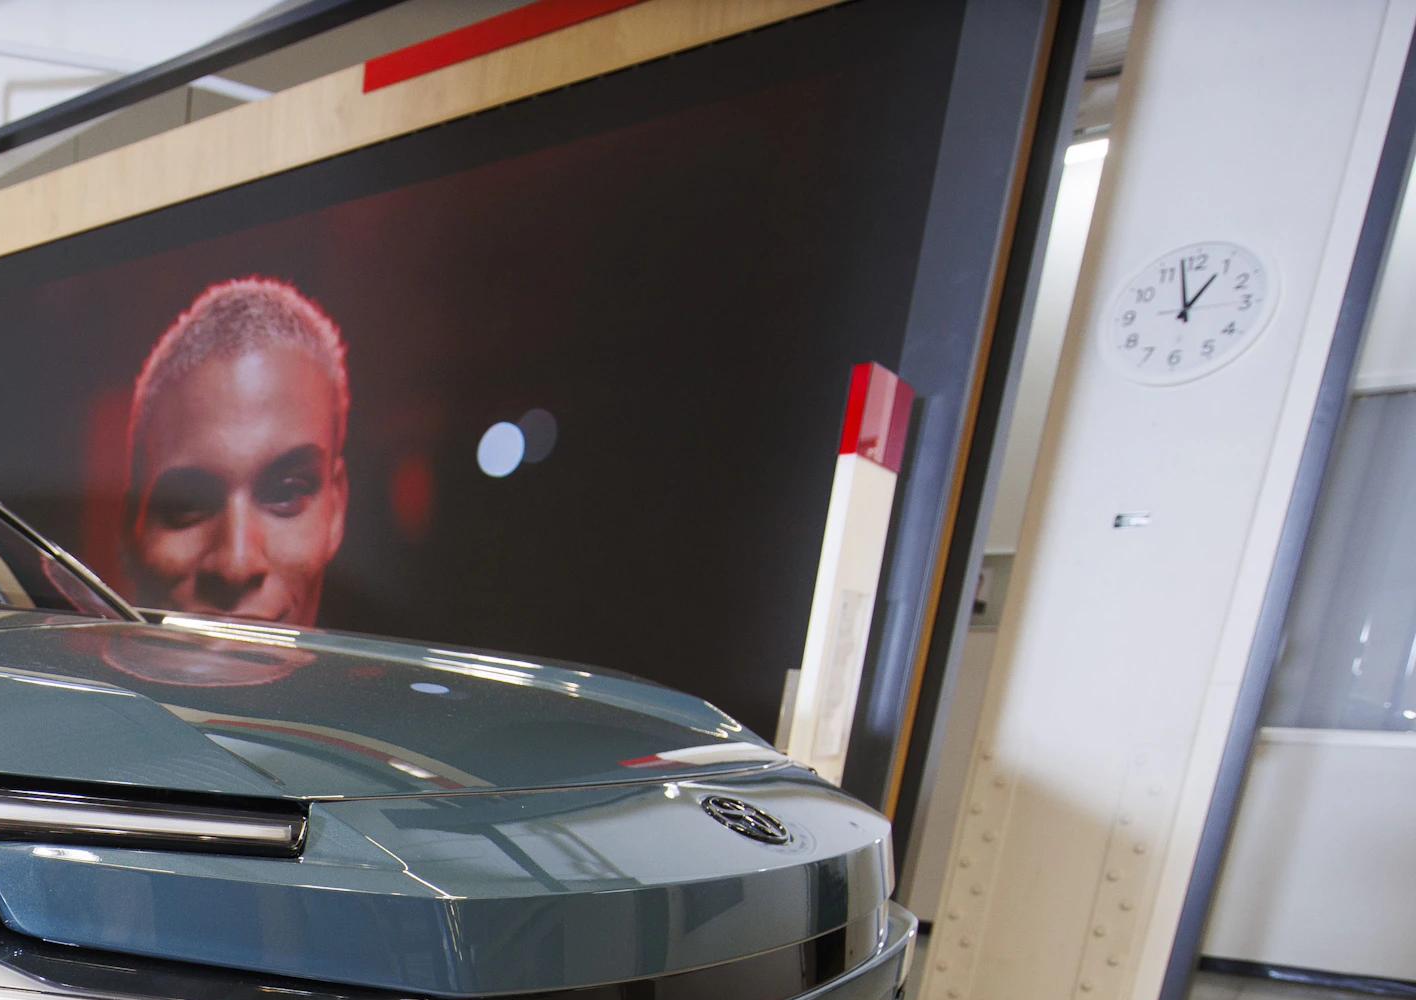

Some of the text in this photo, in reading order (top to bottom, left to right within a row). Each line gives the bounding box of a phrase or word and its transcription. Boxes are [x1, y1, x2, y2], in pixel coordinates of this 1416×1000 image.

[1187, 254, 1208, 272] 12
[1222, 258, 1231, 274] 1
[1159, 268, 1176, 283] 11
[1234, 273, 1250, 290] 2
[1135, 286, 1155, 303] 10
[1238, 294, 1253, 311] 3
[1122, 310, 1136, 327] 9
[1221, 321, 1236, 335] 4
[1125, 333, 1139, 349] 8
[1201, 339, 1215, 356] 5
[1141, 346, 1156, 364] 7
[1167, 349, 1183, 367] 6
